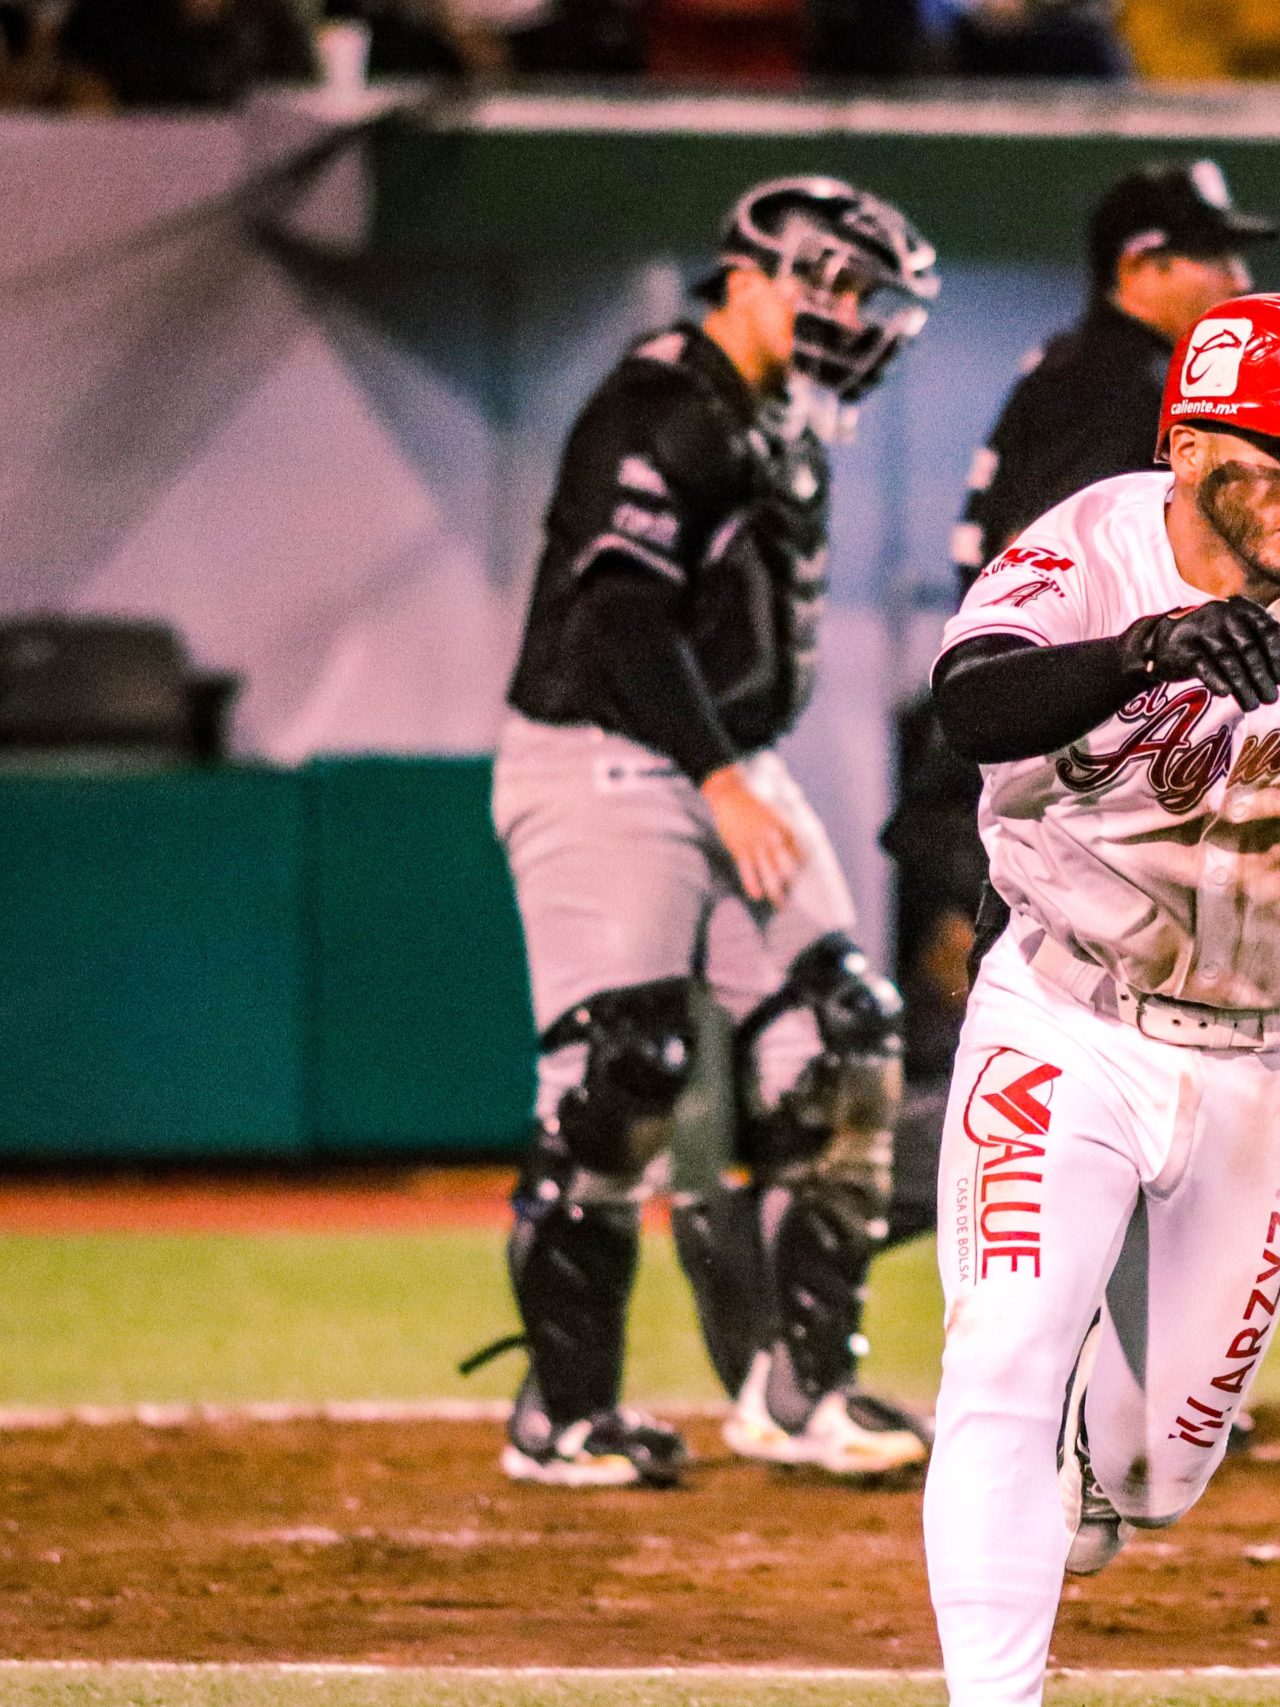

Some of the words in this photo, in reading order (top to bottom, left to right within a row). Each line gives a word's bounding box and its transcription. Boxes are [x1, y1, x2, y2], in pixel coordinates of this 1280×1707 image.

[1170, 399, 1239, 415] caliente.mx
[980, 1063, 1063, 1280] VALUE
[956, 1177, 968, 1213] CASA
[956, 1216, 968, 1235] DE
[957, 1238, 969, 1282] BOLSA
